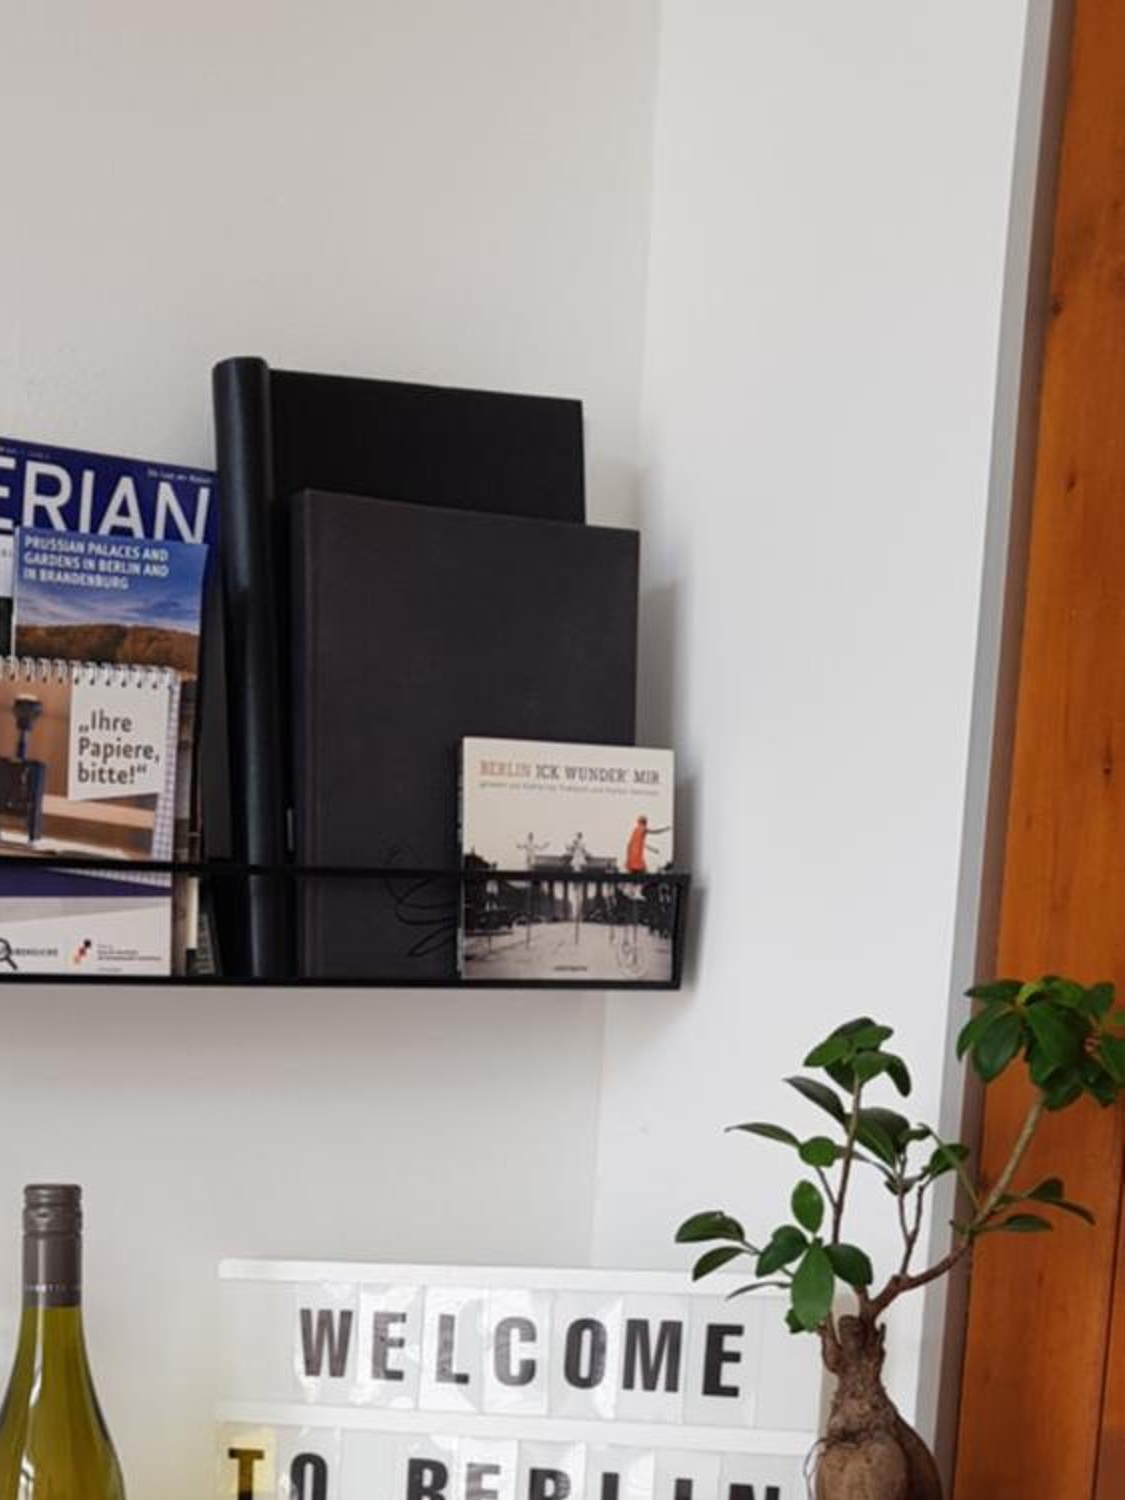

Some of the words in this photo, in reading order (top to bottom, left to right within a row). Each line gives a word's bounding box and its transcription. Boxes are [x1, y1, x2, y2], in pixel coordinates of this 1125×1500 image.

[25, 534, 84, 553] PRUSSIAN
[87, 540, 140, 559] PALACES
[142, 547, 169, 561] AND
[25, 551, 81, 569] GARDENS
[82, 556, 97, 570] IN
[98, 557, 142, 575] BERLIN
[143, 562, 170, 577] AND
[23, 567, 37, 580] IN
[39, 569, 129, 590] BRANDENBURG
[78, 736, 160, 765] Papiere,
[479, 760, 531, 778] BERLIN
[536, 764, 560, 780] ICK
[634, 769, 660, 785] MIR
[300, 1308, 744, 1397] WELCOME
